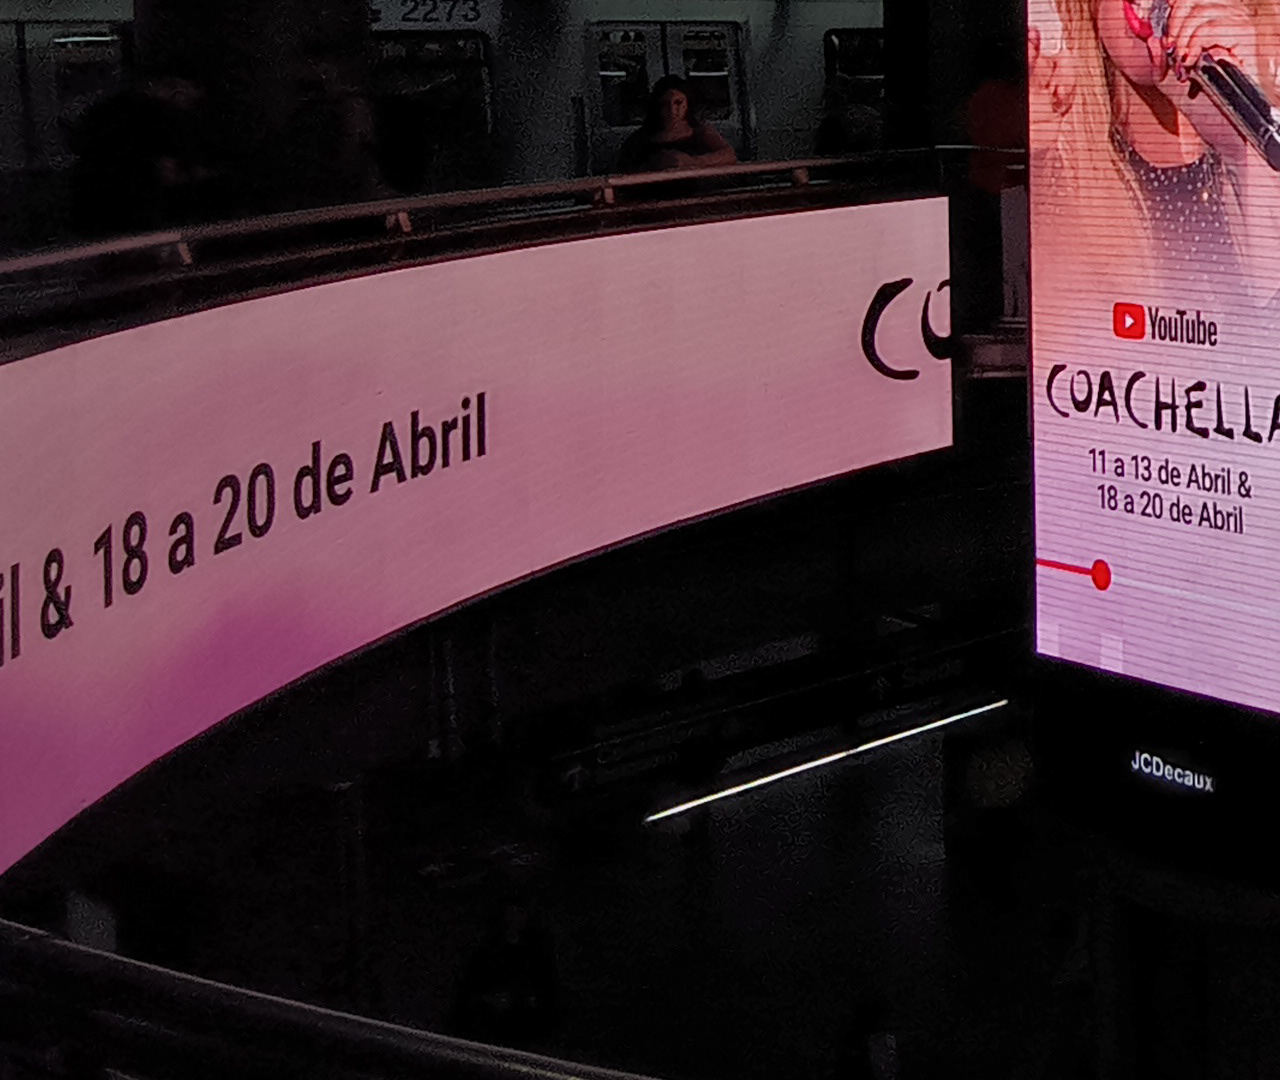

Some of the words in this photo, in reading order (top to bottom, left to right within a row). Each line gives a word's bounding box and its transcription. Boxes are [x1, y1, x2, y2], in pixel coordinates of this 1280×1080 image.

[1148, 307, 1217, 346] YouTube
[1089, 449, 1106, 474] 11
[1114, 458, 1125, 477] a
[1131, 455, 1151, 482] 13
[1158, 459, 1181, 486] de
[1187, 464, 1231, 495] Abril
[1238, 471, 1252, 498] &
[41, 548, 74, 639] &
[94, 511, 147, 609] 18
[168, 512, 195, 574] a
[213, 463, 275, 555] 20
[294, 440, 354, 520] de
[370, 392, 486, 494] Abril
[1098, 484, 1118, 511] 18
[1124, 493, 1135, 513] a
[1140, 491, 1163, 518] 20
[1170, 495, 1193, 524] de
[1199, 502, 1243, 534] Abril
[1131, 749, 1214, 793] JCDecaux
